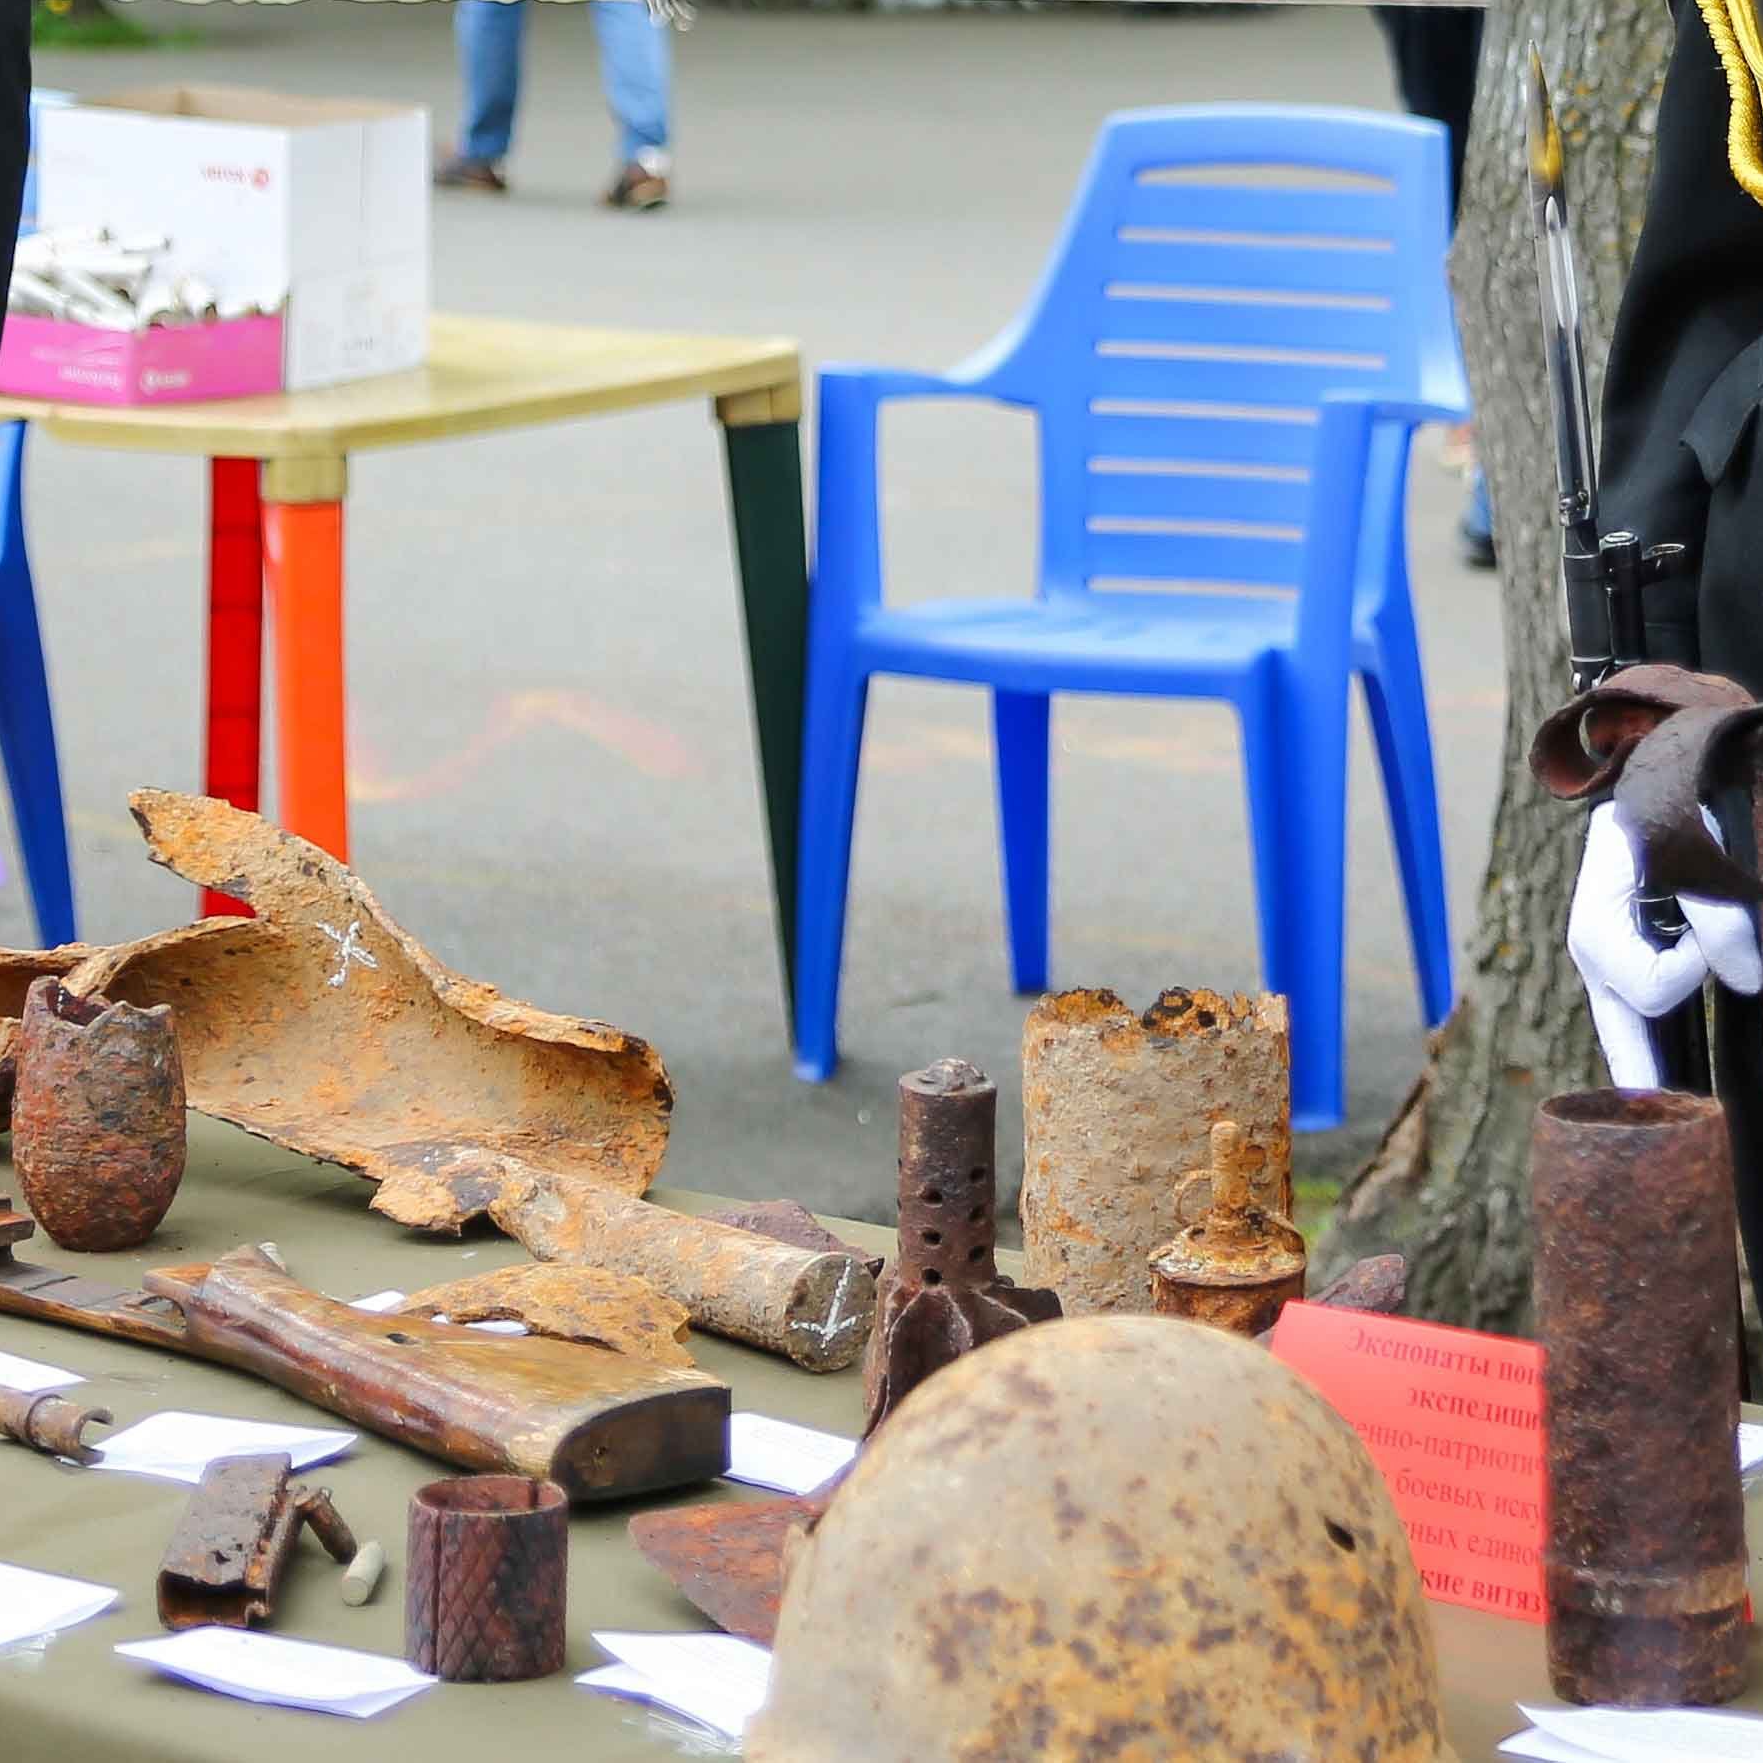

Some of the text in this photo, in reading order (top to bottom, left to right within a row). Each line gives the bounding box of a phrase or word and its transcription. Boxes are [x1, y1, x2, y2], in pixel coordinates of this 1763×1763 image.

[1343, 1324, 1491, 1378] Экспонаты
[1350, 1421, 1542, 1477] енно-патриоти
[1396, 1467, 1487, 1511] боевых
[1402, 1519, 1543, 1566] ных едино
